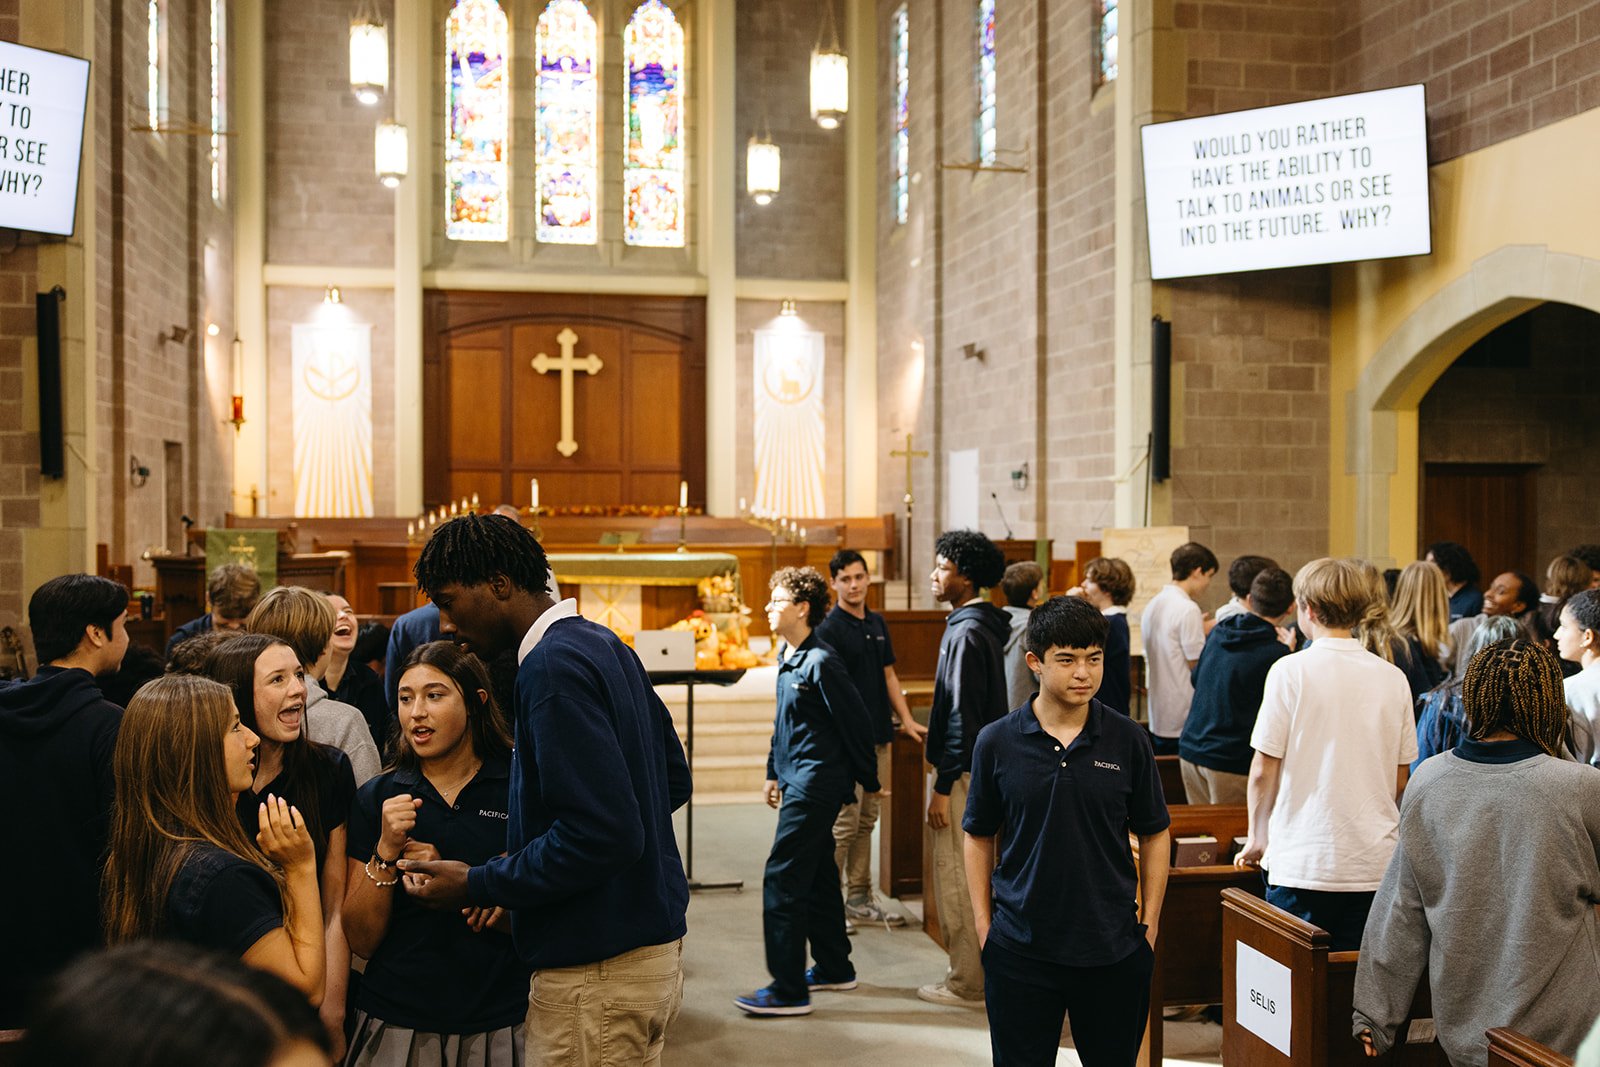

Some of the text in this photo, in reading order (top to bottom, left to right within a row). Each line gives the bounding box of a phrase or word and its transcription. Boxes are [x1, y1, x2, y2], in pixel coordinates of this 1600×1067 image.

[9, 103, 31, 129] TO
[14, 138, 48, 165] SEE
[1193, 117, 1366, 160] WOULD YOU RATHER
[1192, 146, 1372, 188] HAVE THE ABILITY TO
[1176, 174, 1393, 219] TALK TO ANIMALS OR SEE
[1180, 225, 1217, 247] INTO
[1223, 220, 1253, 242] THE
[1340, 205, 1392, 231] WHY?
[1094, 760, 1120, 770] PACIFICA
[1250, 988, 1276, 1015] SELIS
